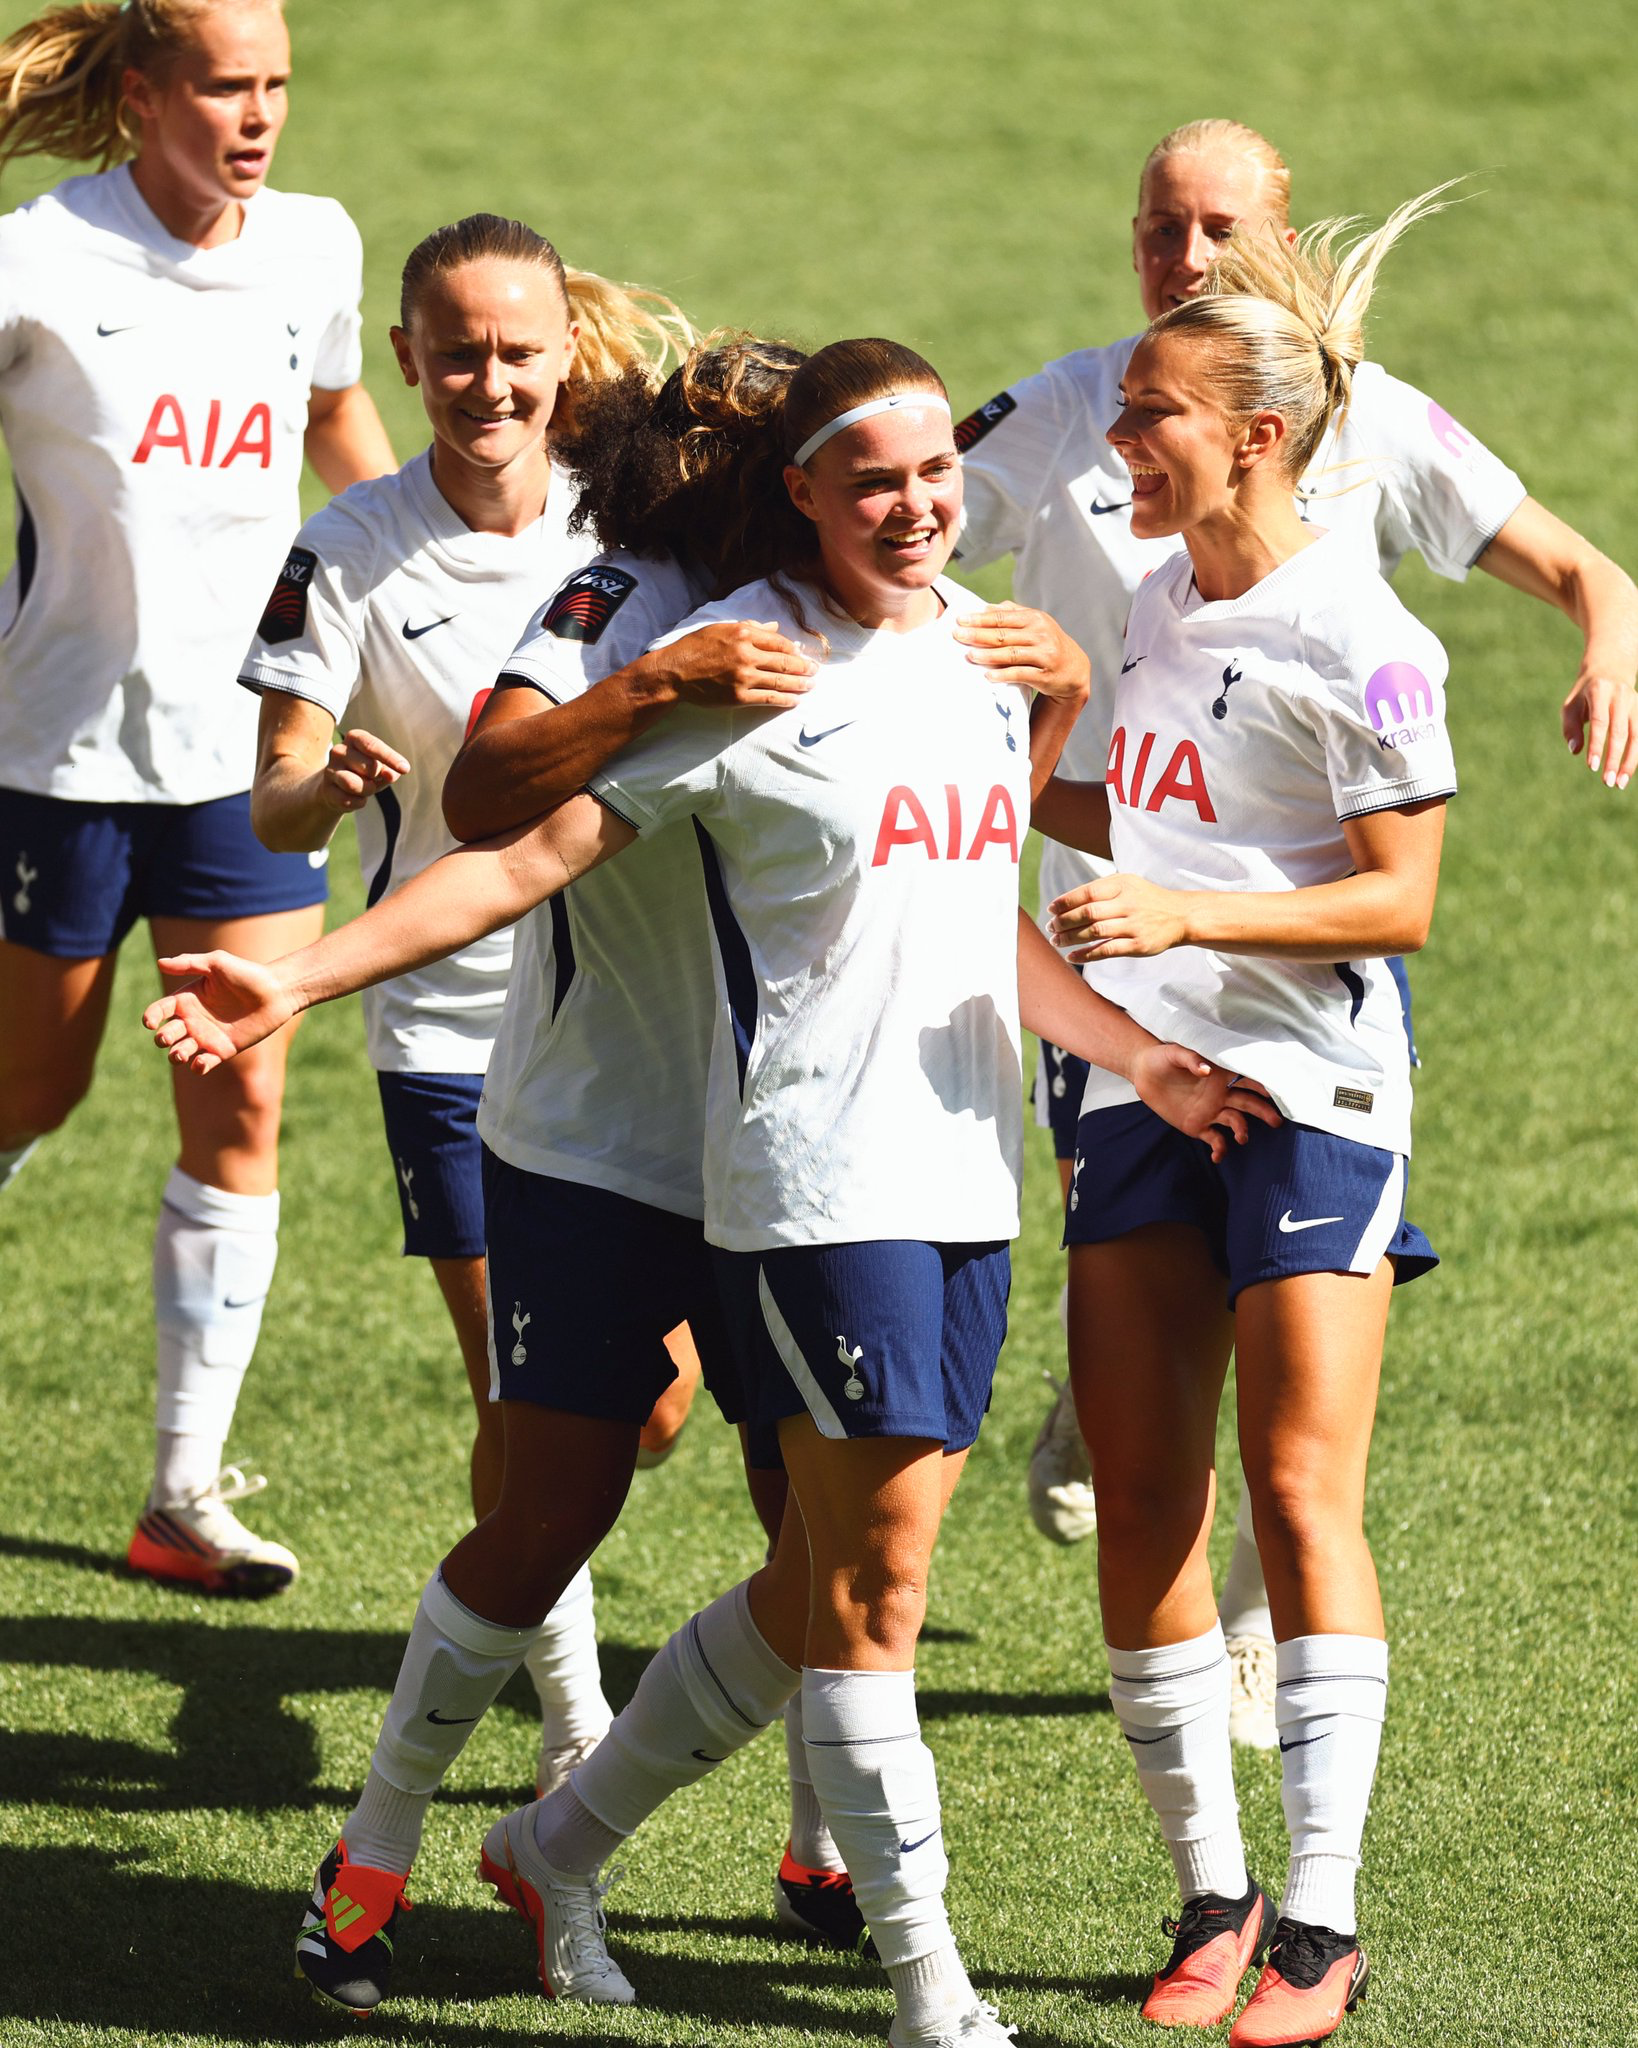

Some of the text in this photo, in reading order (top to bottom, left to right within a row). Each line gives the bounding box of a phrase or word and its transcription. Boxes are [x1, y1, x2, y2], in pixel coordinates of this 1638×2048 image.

[131, 393, 271, 469] AIA
[281, 561, 308, 583] SL
[1105, 726, 1218, 824] AIA
[871, 784, 1018, 867] AIA
